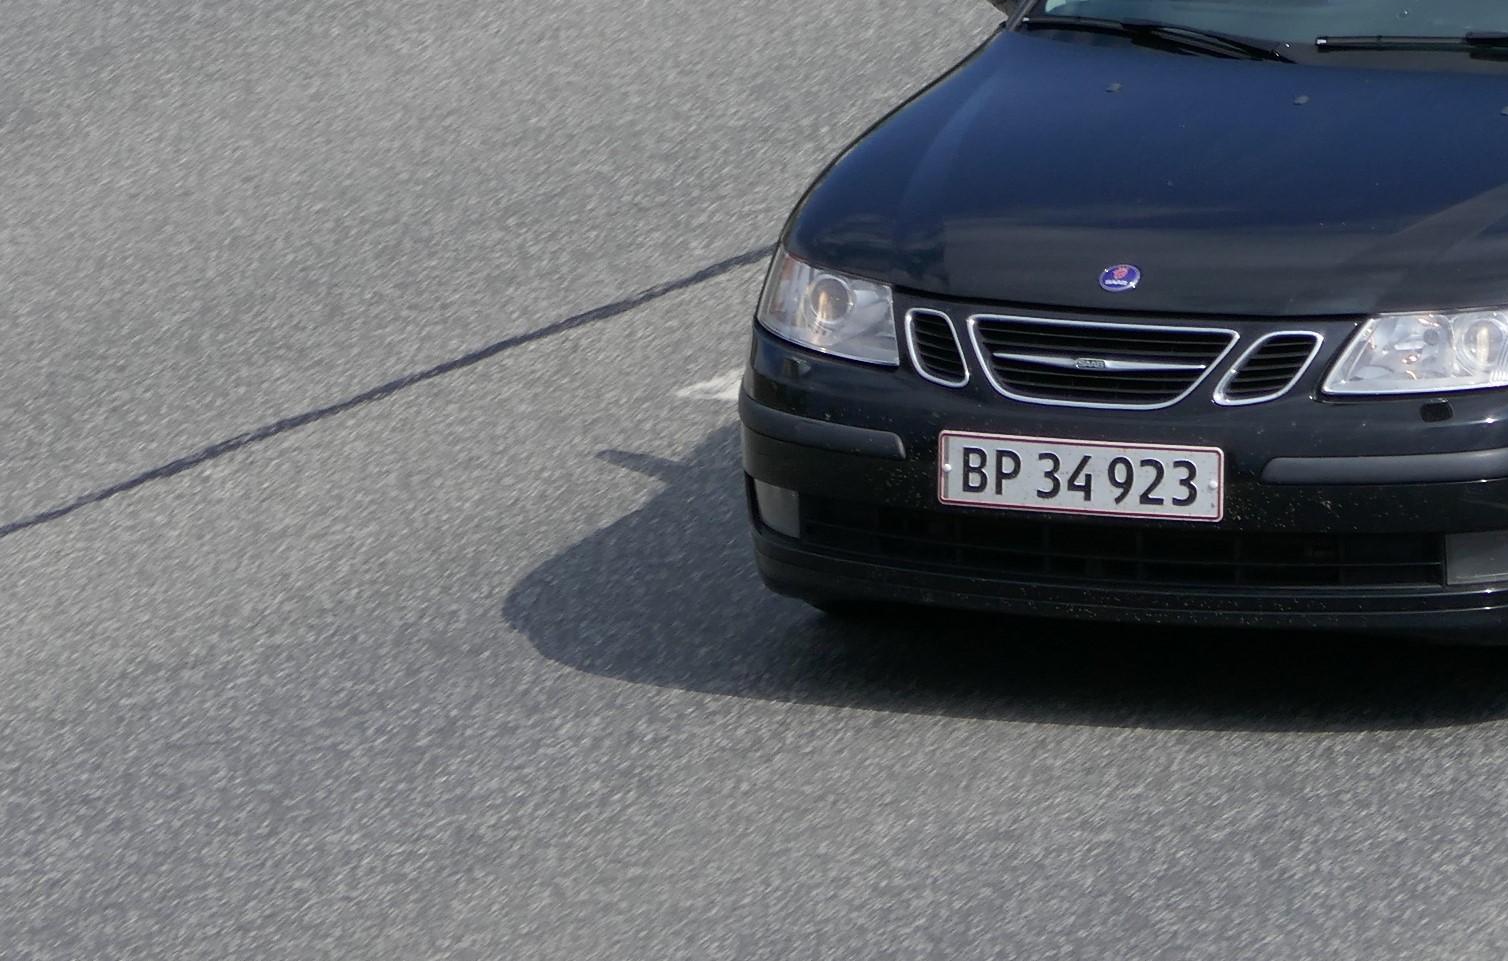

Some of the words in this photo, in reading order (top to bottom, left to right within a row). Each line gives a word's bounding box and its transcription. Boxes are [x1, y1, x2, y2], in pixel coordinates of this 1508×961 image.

[962, 446, 1022, 496] BP
[1036, 451, 1093, 502] 34
[1107, 456, 1198, 507] 923
